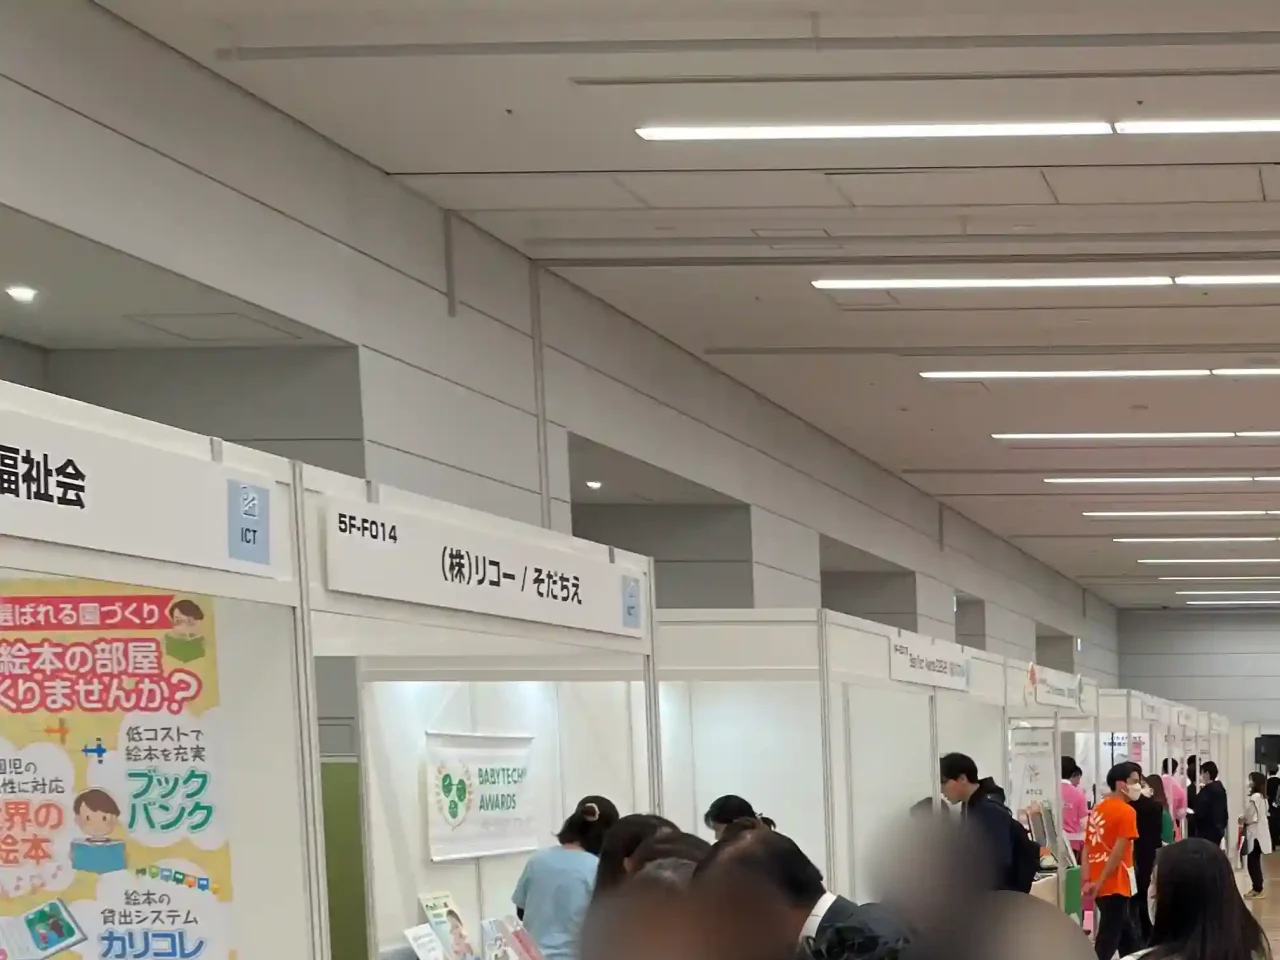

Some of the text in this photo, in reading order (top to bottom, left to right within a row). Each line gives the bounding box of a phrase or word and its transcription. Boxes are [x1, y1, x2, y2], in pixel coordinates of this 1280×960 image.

[240, 526, 258, 545] ICT
[338, 512, 398, 543] 5F-F014
[0, 641, 160, 675] 絵本の部屋
[125, 726, 204, 743] 低コストで
[125, 745, 207, 763] 絵本を充実
[0, 777, 65, 794] 性に対応
[127, 769, 209, 799] ブック
[479, 794, 516, 811] AWARDS
[0, 800, 64, 832] 界の
[127, 801, 214, 831] バンク
[124, 890, 171, 906] 絵本の
[100, 930, 205, 959] カリコレ
